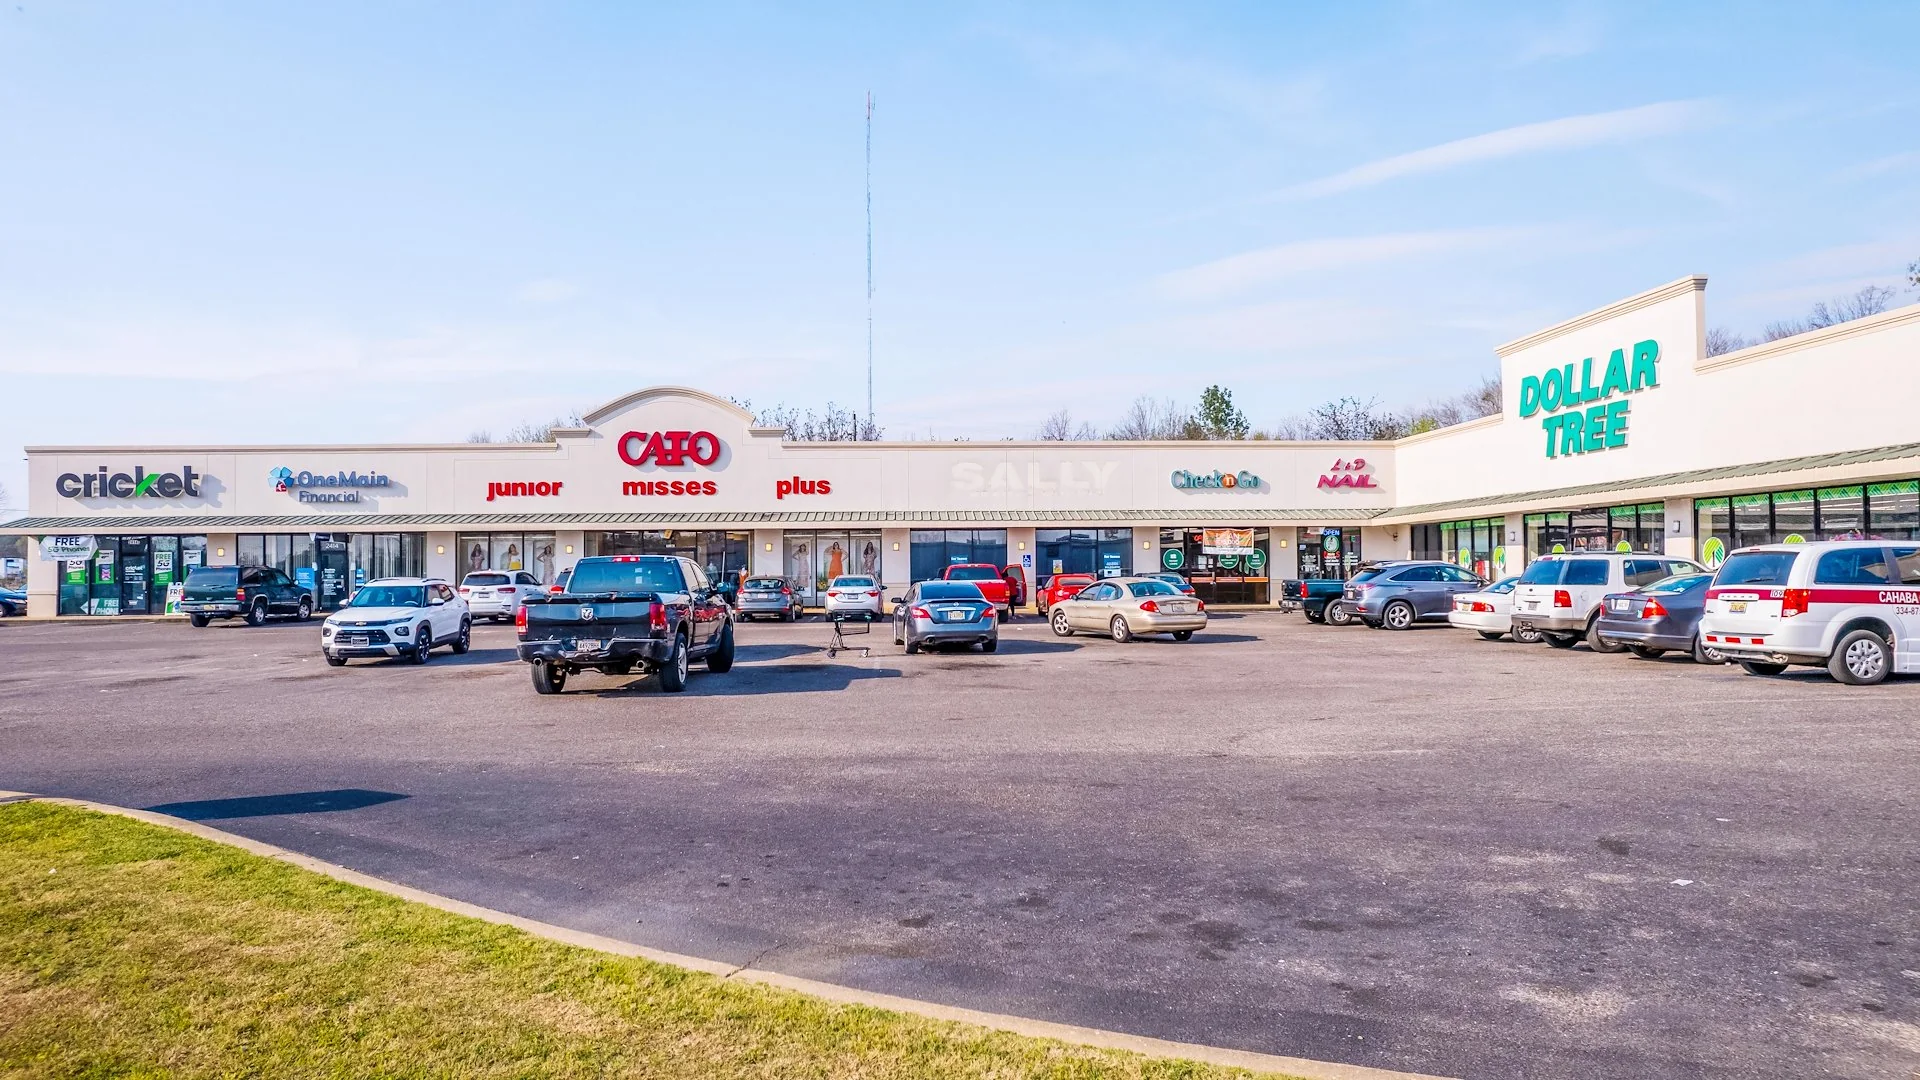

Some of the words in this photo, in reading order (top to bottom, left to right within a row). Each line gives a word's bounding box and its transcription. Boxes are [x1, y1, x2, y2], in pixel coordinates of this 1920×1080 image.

[1519, 339, 1660, 418] DOLLAR
[1542, 399, 1630, 458] TREE
[617, 431, 720, 466] CATO
[55, 465, 199, 498] cricket
[298, 470, 389, 488] OneMain
[951, 461, 1120, 491] SALLY
[1237, 469, 1261, 489] Go
[1317, 474, 1377, 488] NAIL
[299, 490, 360, 503] Financial
[486, 481, 563, 502] junior
[622, 480, 717, 496] misses
[776, 476, 831, 500] plus
[55, 537, 80, 546] FREE
[156, 559, 170, 567] 5G
[1879, 591, 1919, 604] CAHABA
[1895, 606, 1920, 615] 334-87
